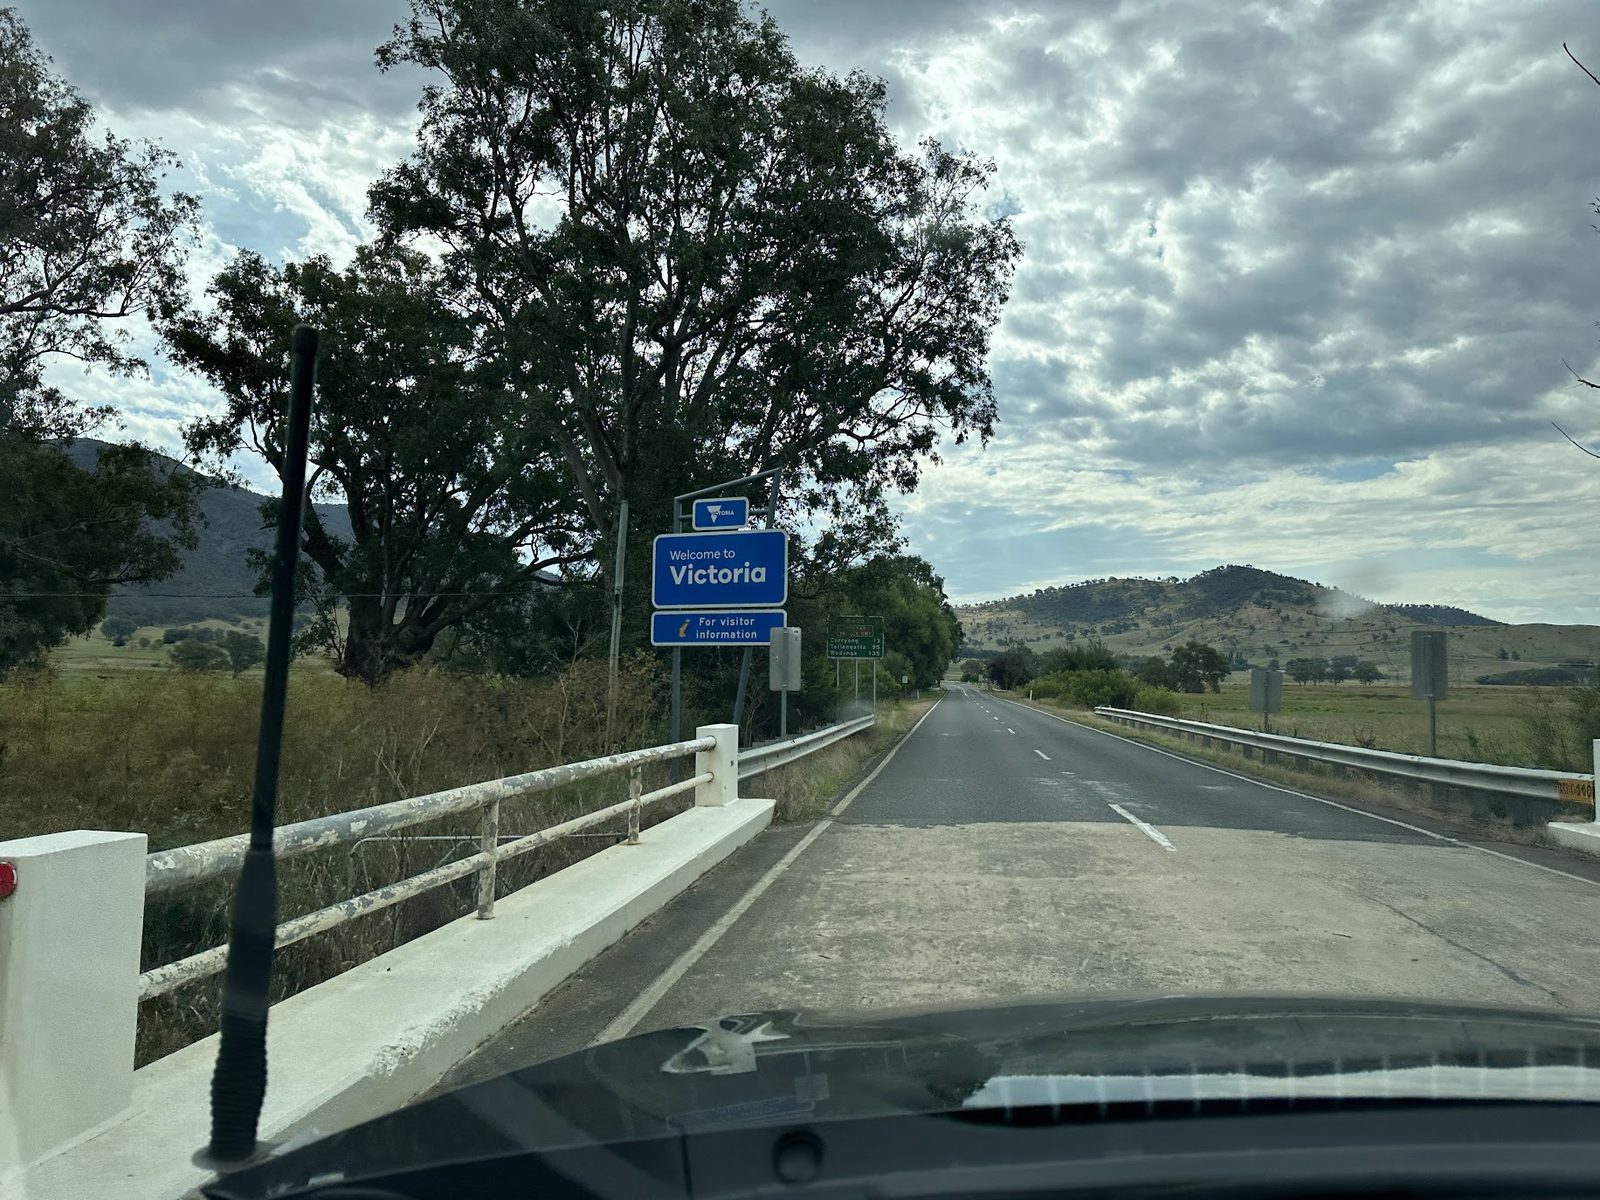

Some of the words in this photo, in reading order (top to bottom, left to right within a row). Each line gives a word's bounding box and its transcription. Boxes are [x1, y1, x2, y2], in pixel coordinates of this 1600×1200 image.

[706, 505, 734, 523] VTORIA
[670, 549, 720, 560] Welcome
[723, 549, 736, 559] to
[669, 561, 766, 585] Victoria
[699, 617, 716, 626] For
[720, 616, 755, 626] visitor
[696, 629, 757, 639] information
